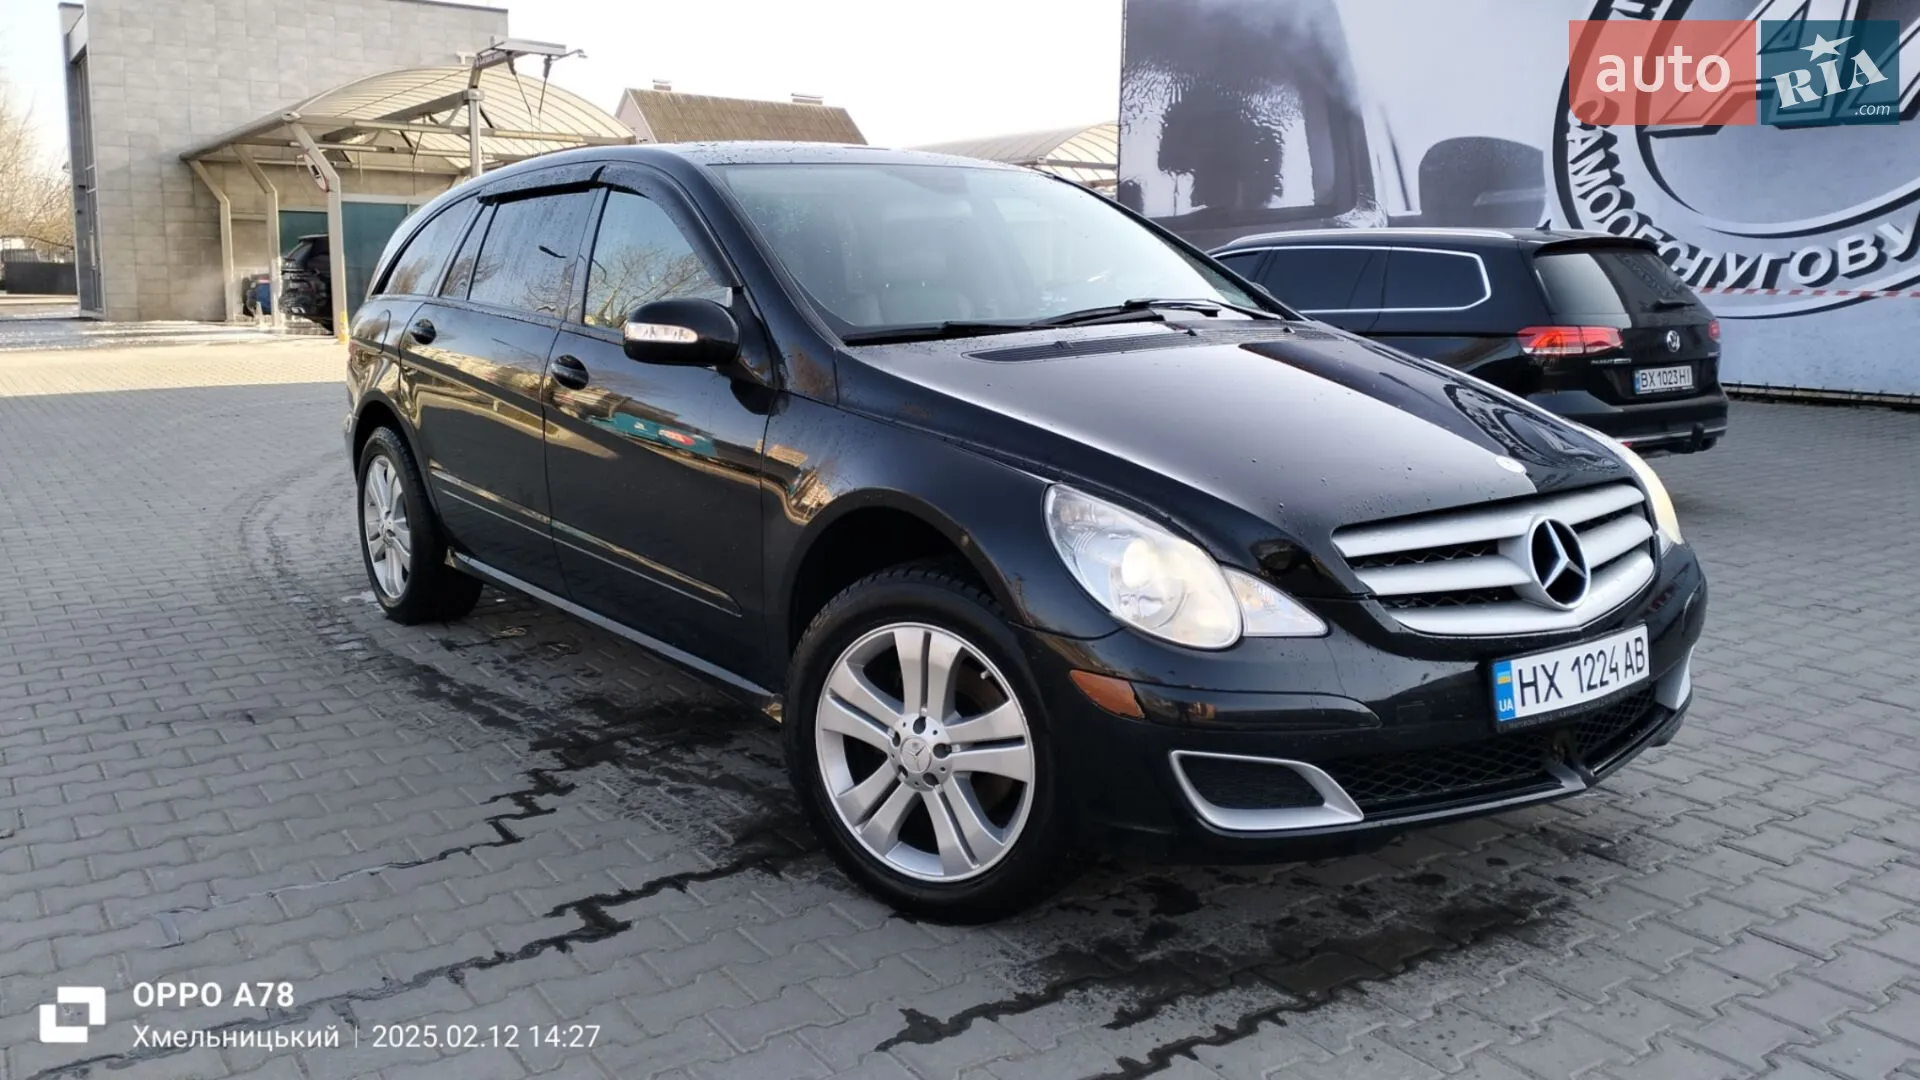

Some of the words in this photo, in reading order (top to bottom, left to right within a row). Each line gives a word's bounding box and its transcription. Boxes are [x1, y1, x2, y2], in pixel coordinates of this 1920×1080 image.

[1518, 660, 1563, 707] HX
[1570, 645, 1619, 694] 1224
[1624, 636, 1645, 678] AB
[1499, 699, 1514, 712] UA
